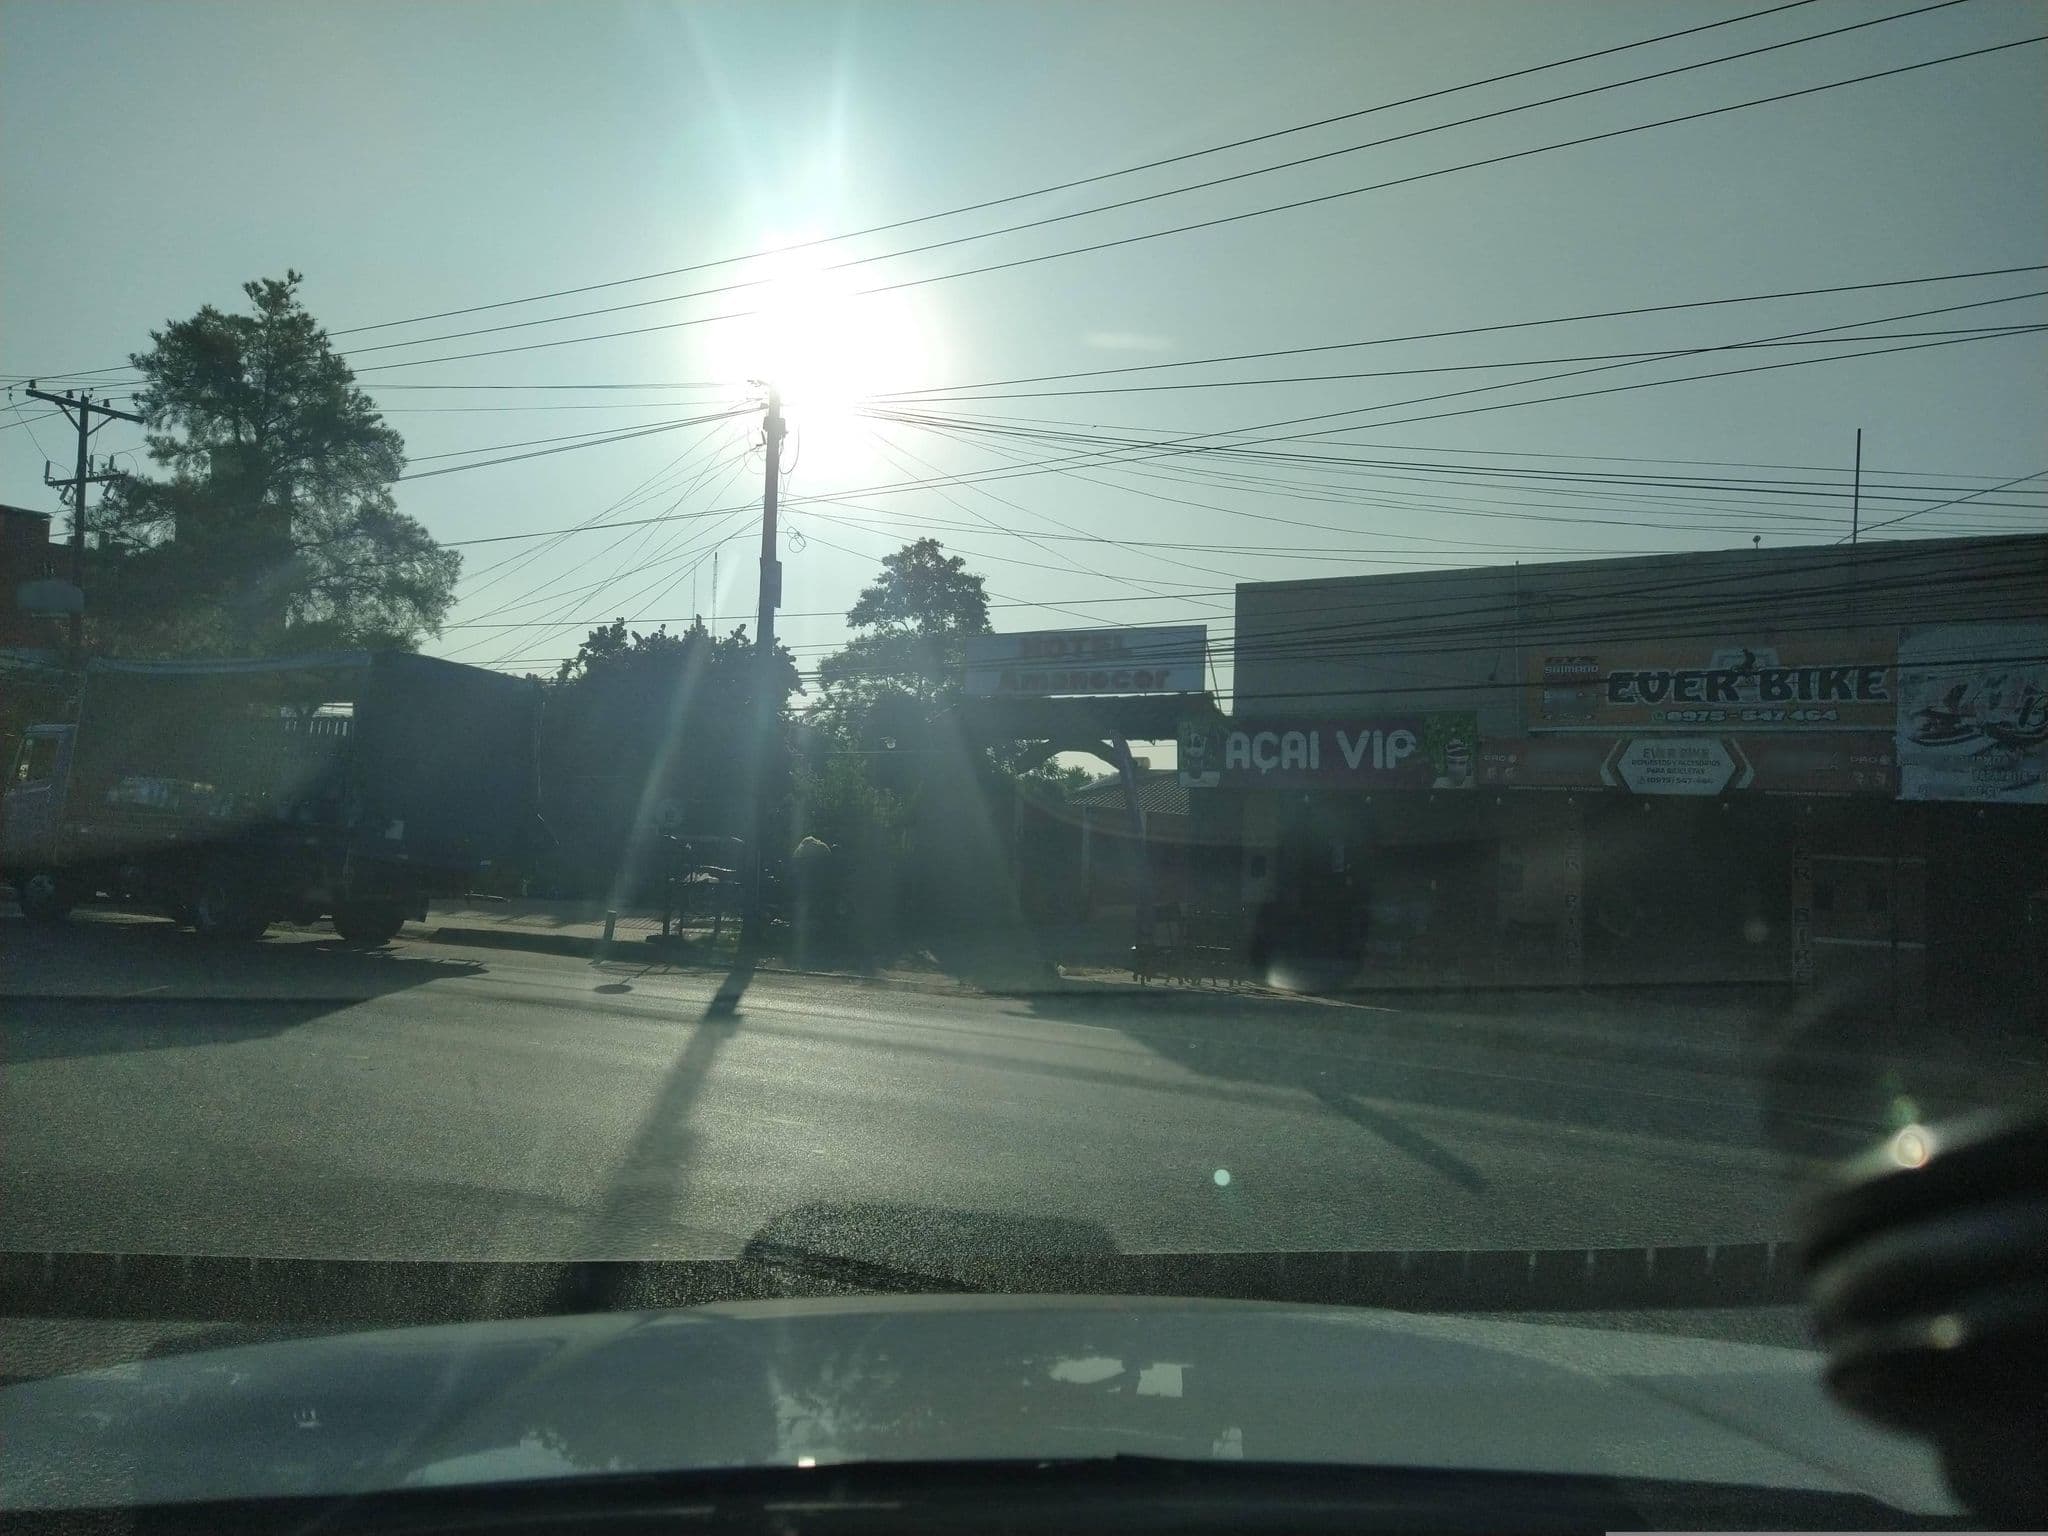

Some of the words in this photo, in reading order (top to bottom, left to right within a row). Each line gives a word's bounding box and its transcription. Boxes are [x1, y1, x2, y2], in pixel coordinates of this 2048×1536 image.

[1607, 669, 1742, 704] EVER
[1758, 665, 1889, 703] BIKE
[1336, 729, 1418, 770] VIP
